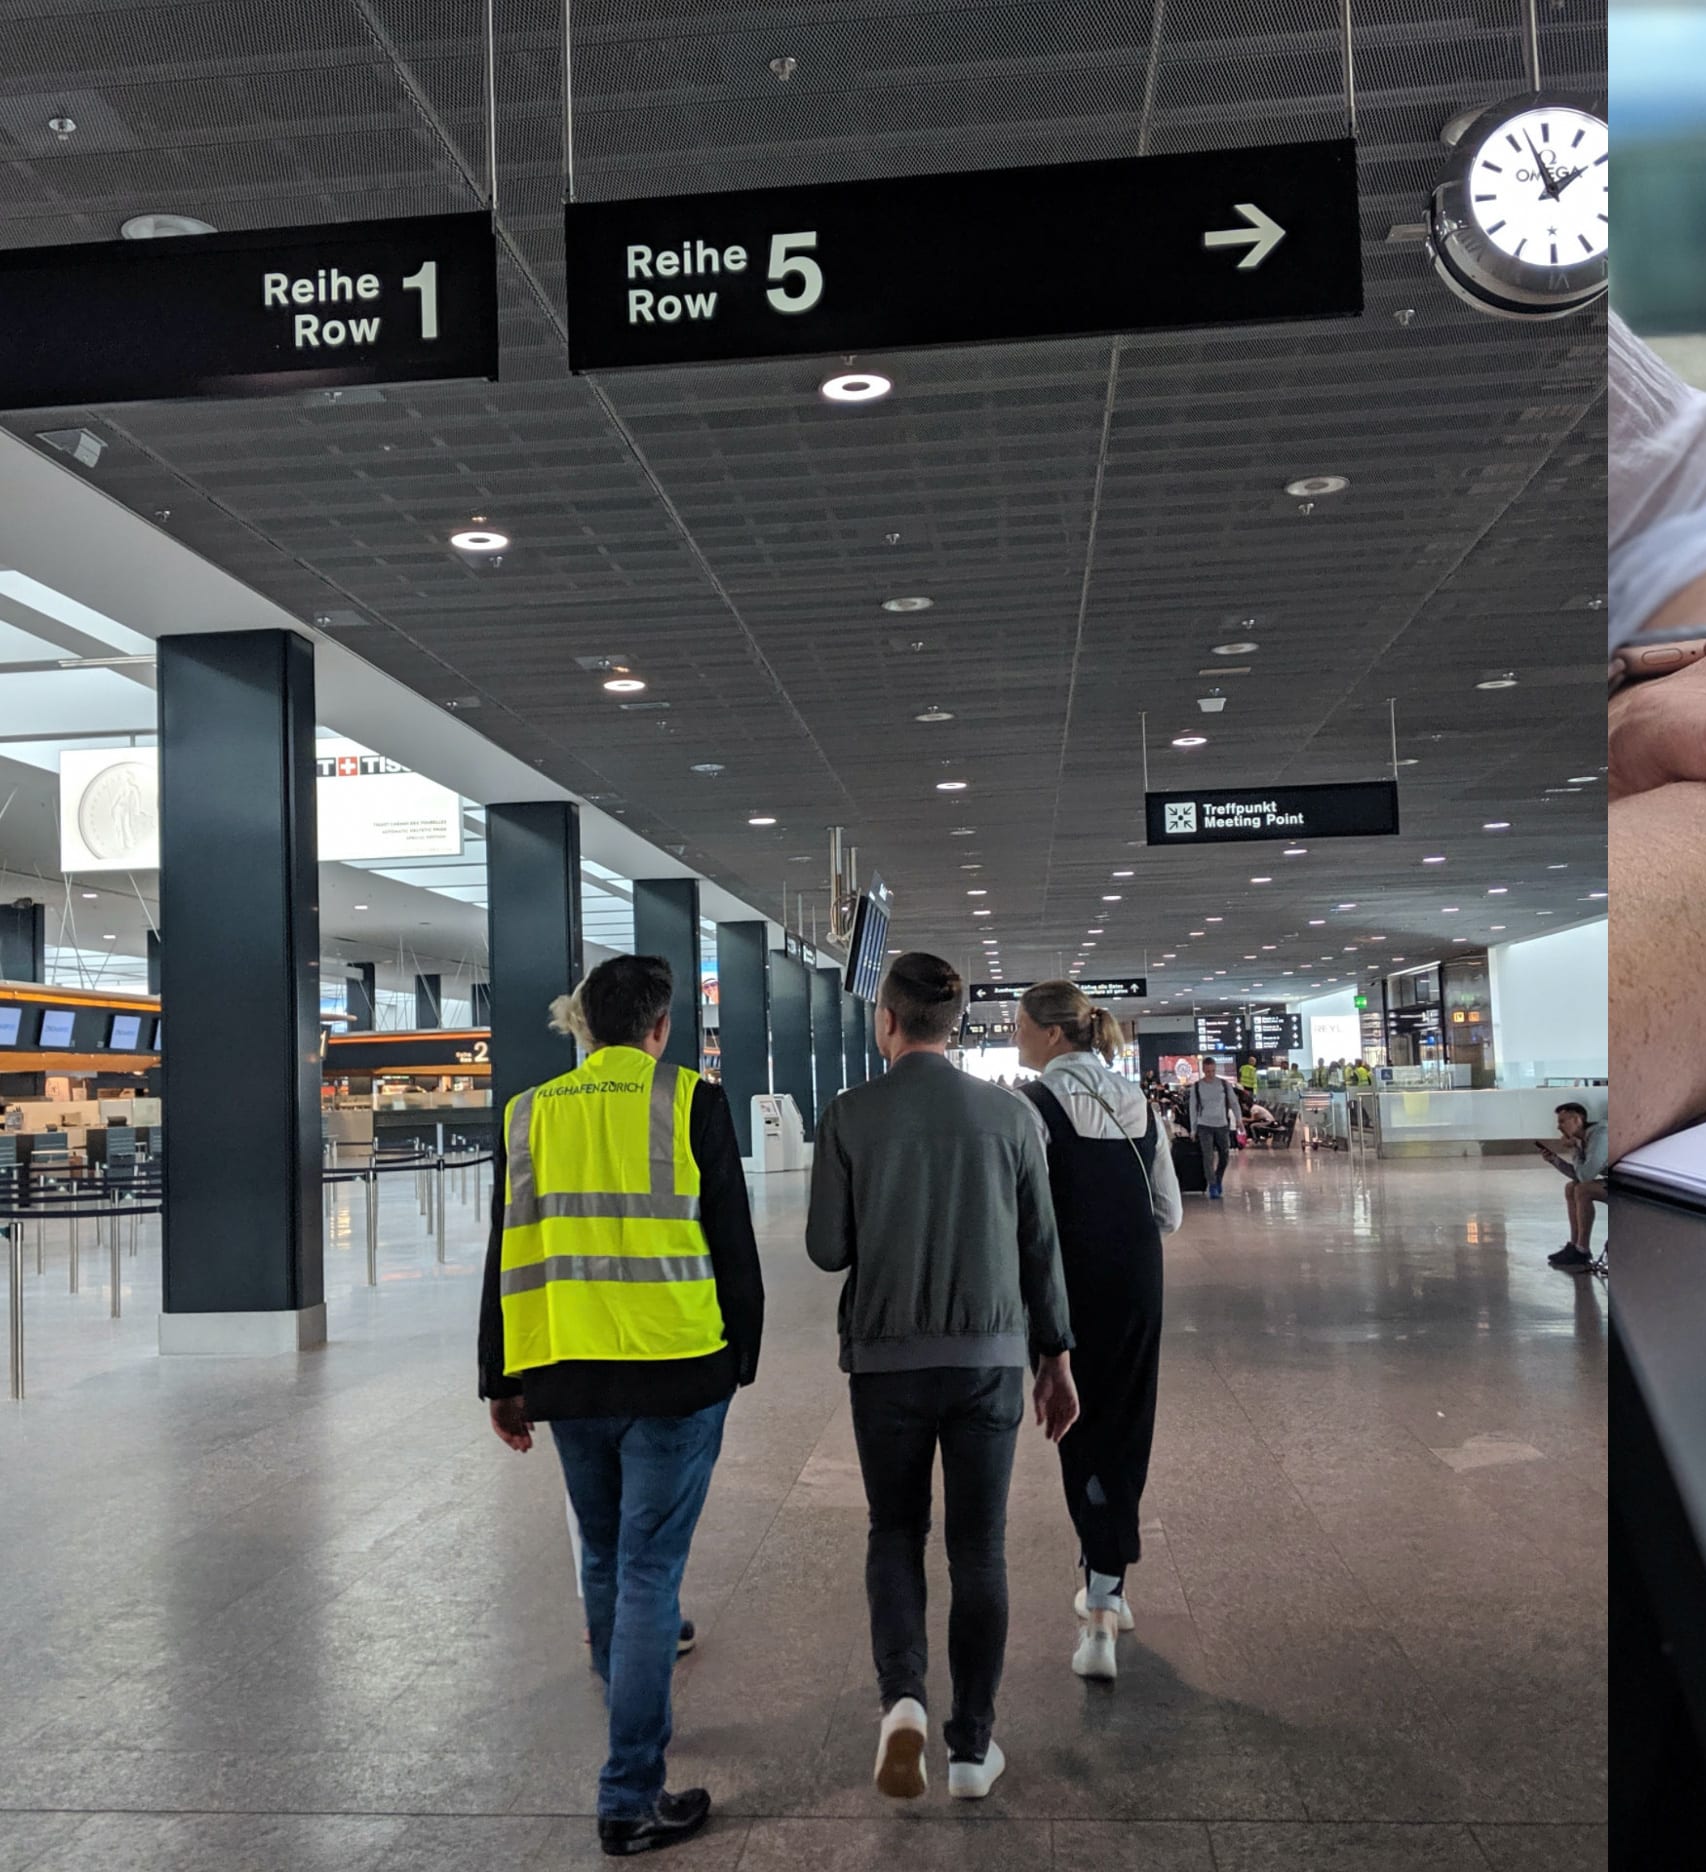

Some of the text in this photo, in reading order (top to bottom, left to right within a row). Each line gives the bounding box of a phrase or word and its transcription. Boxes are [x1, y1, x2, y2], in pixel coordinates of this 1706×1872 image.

[627, 239, 748, 280] Reihe
[766, 231, 823, 313] 5
[264, 268, 380, 307] Reihe
[402, 261, 438, 339] 1
[628, 289, 718, 323] Row
[294, 313, 381, 347] Row
[361, 755, 412, 774] TIS
[1202, 801, 1278, 817] Treffpunkt
[1204, 812, 1305, 829] Meeting Point
[473, 1041, 489, 1063] 2
